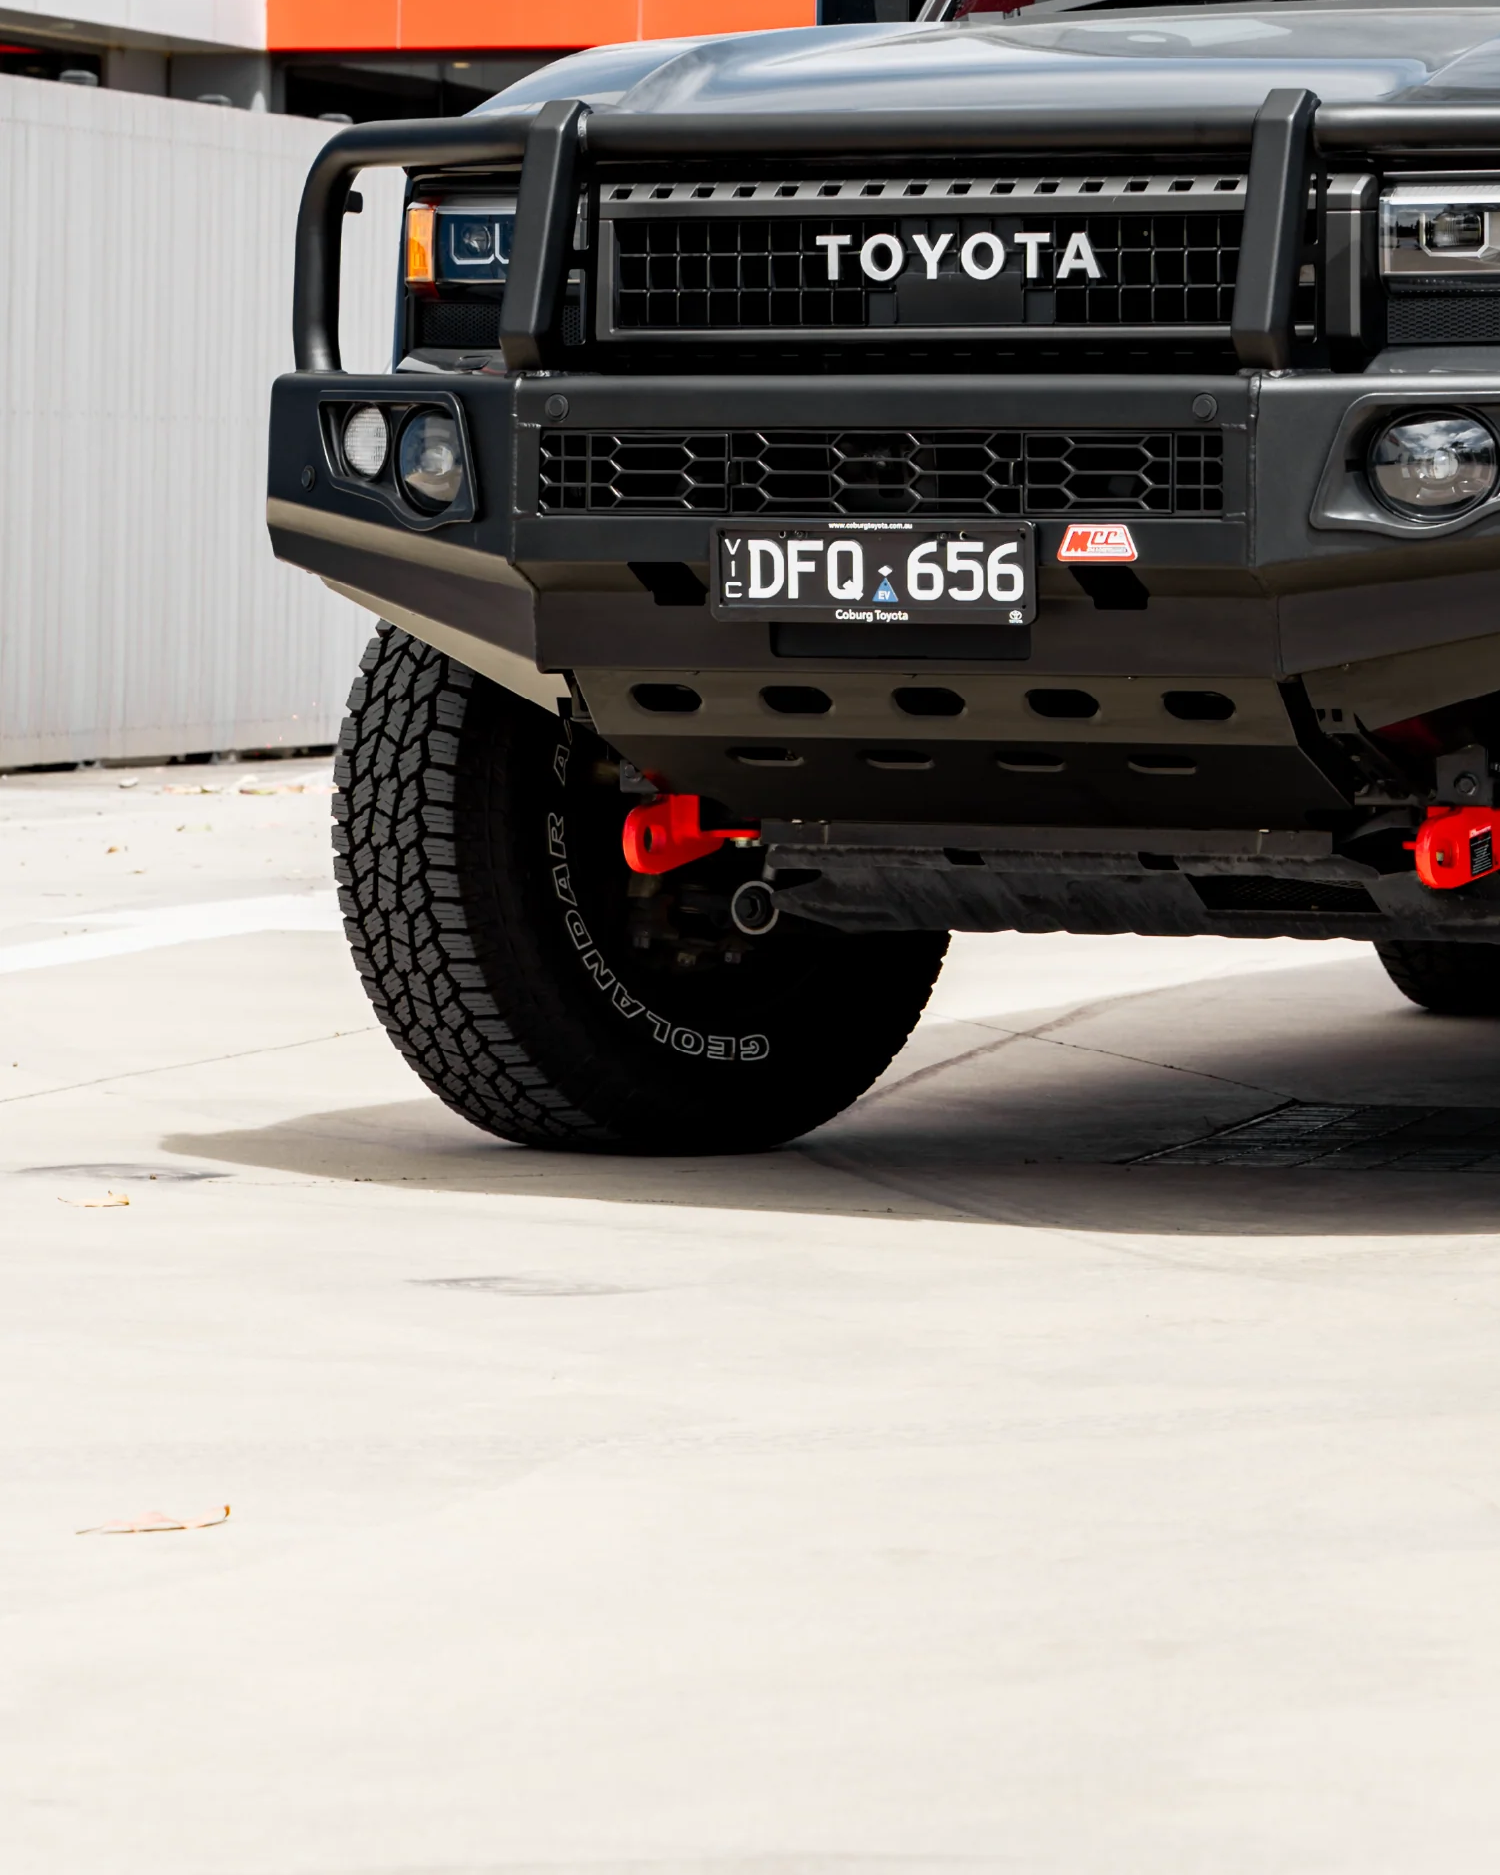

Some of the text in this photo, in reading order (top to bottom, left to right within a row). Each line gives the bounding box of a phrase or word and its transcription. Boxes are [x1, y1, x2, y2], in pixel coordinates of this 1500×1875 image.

[816, 231, 1101, 282] TOYOTA
[828, 521, 913, 531] www.coburgtoyota.com.au
[1066, 531, 1126, 552] MCC
[724, 538, 743, 598] VIC
[748, 539, 1024, 602] DFQ 656
[878, 590, 891, 600] EV
[835, 609, 909, 623] Coburg Toyota
[547, 811, 770, 1061] GEOLANDAR
